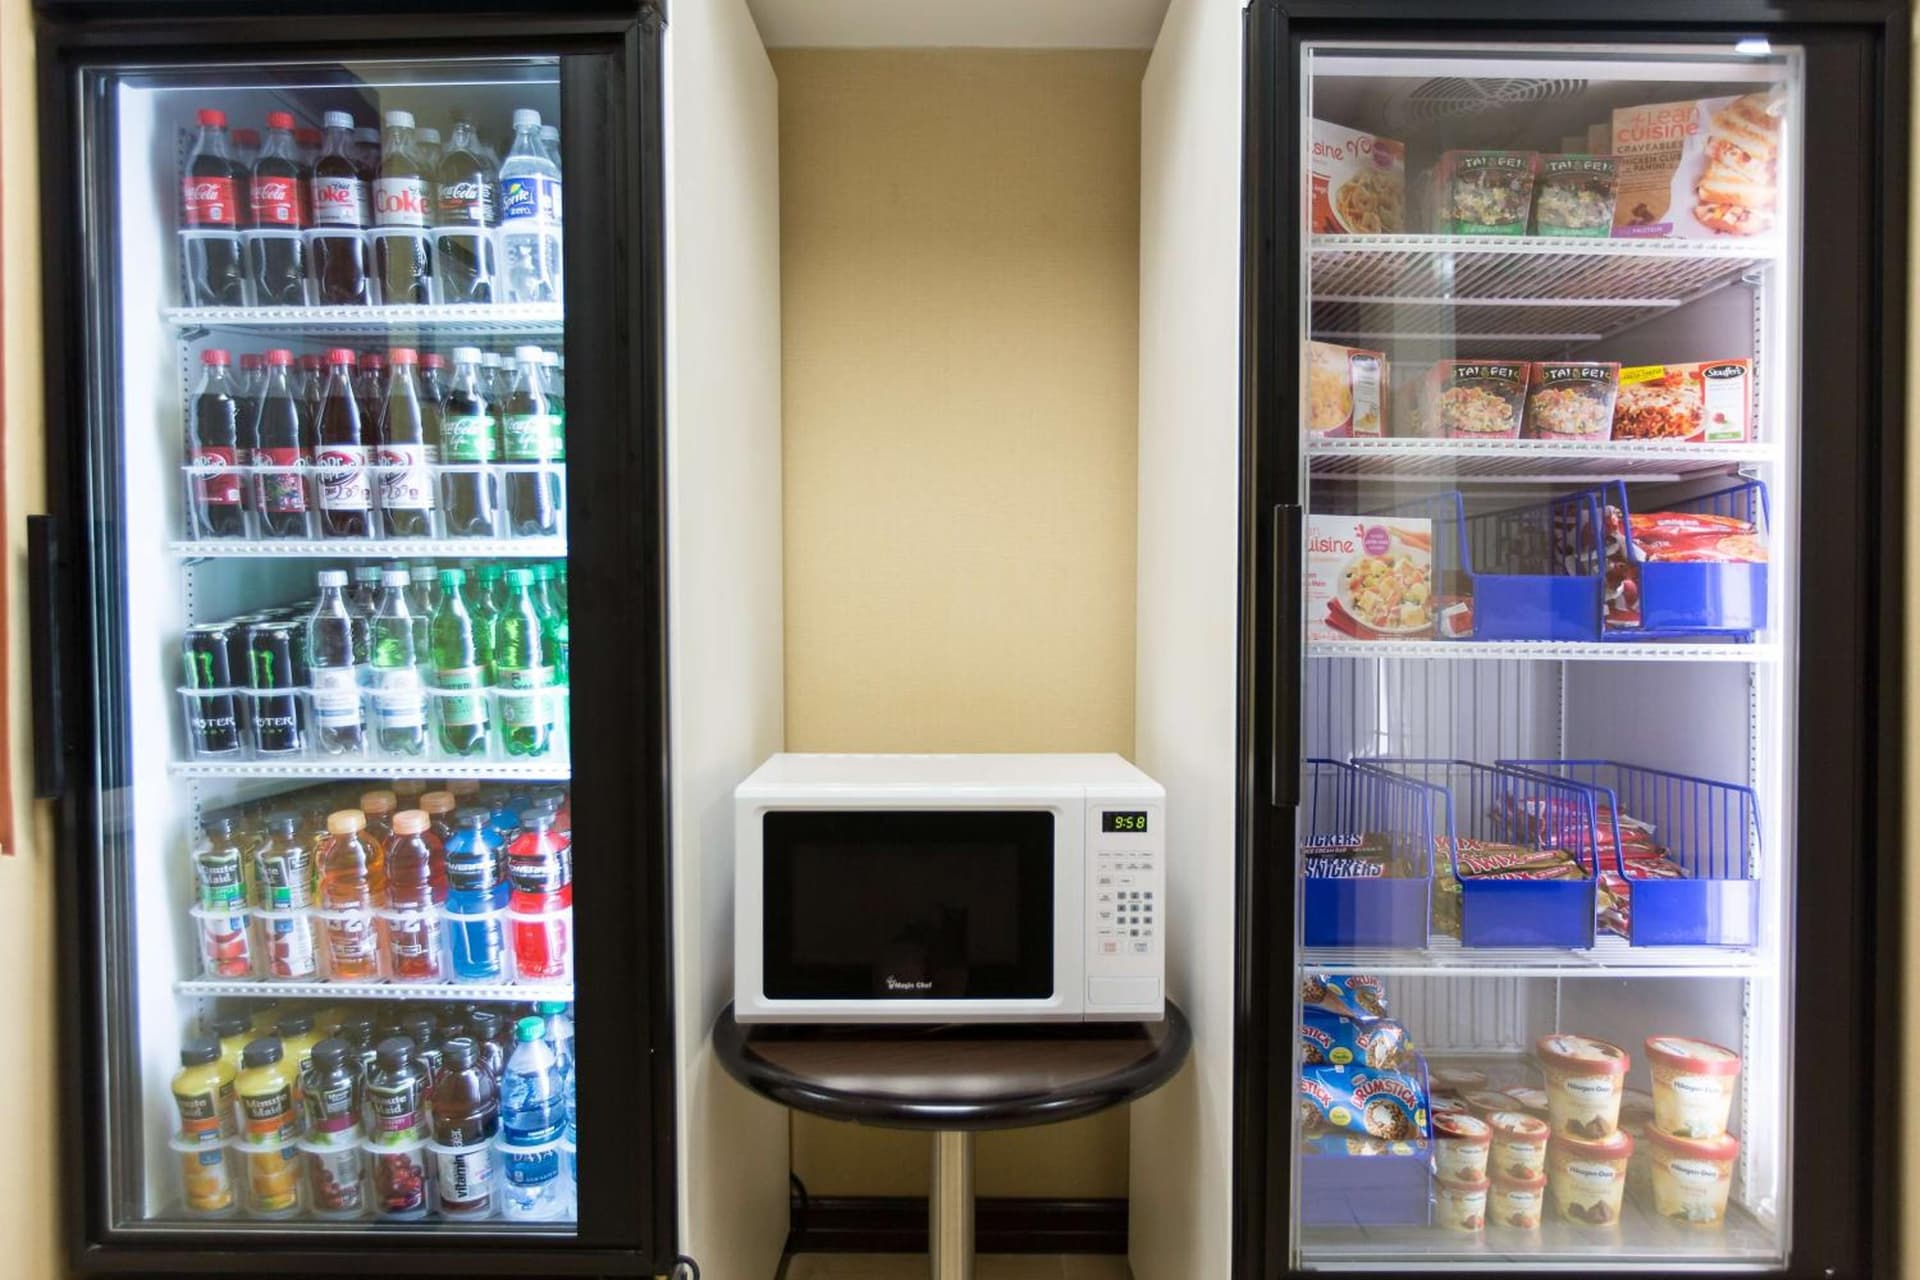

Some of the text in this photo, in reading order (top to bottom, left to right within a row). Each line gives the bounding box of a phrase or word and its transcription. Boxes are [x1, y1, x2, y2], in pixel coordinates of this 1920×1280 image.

[1465, 157, 1521, 168] TAI PEI
[1551, 160, 1607, 171] TAI PEI
[376, 188, 432, 214] Coke
[1458, 367, 1512, 377] TAI PEI
[1550, 367, 1603, 379] TAI PEI
[1115, 816, 1145, 828] 9:58
[1305, 858, 1384, 878] SNICKERS
[1351, 1079, 1418, 1110] DRUMSTICK
[455, 1154, 467, 1198] vitamin
